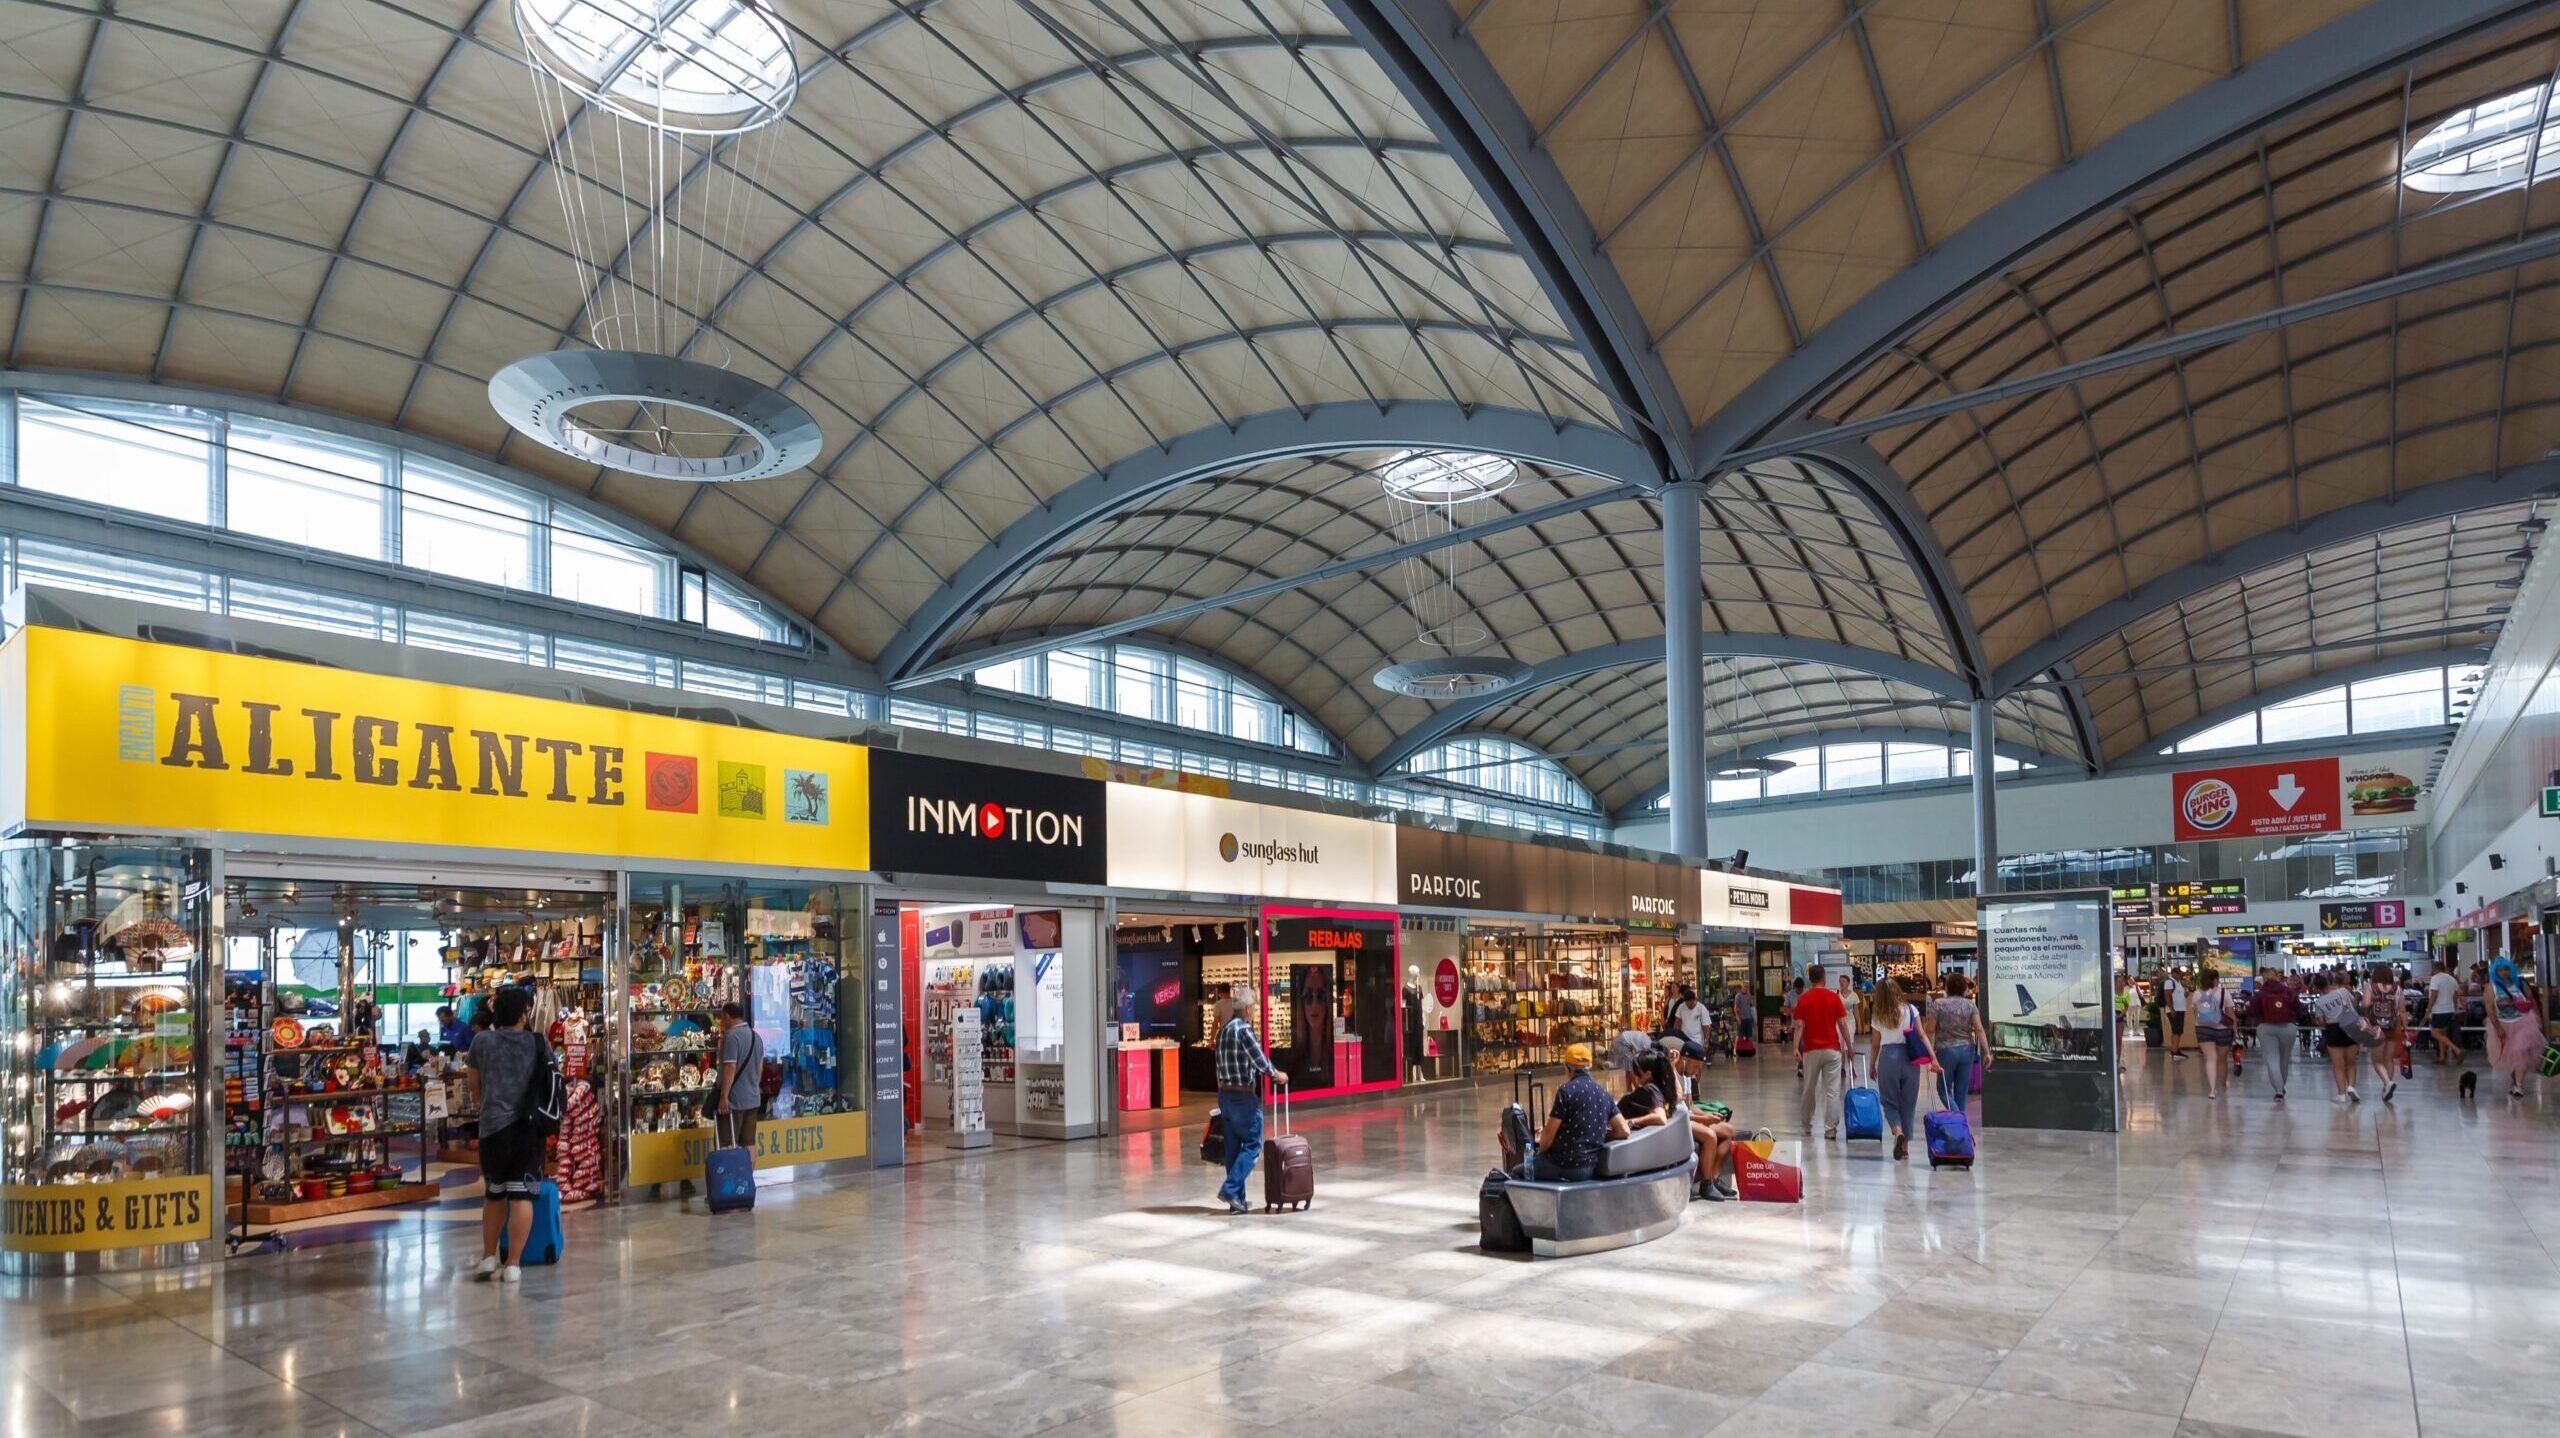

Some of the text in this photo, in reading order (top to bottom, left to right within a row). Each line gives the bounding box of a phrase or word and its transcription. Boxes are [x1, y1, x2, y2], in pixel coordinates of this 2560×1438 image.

[160, 692, 625, 806] ALICANTE
[2345, 772, 2394, 783] WHOPPER
[2190, 788, 2228, 808] BURGER
[2192, 796, 2231, 820] KING
[2250, 818, 2270, 826] JUSTO
[2292, 815, 2308, 823] JUST
[2309, 813, 2327, 822] HERE
[1242, 839, 1319, 865] sunglass hut
[1411, 873, 1480, 898] PARFOIS
[1632, 895, 1675, 915] PARFOIS
[1733, 890, 1766, 906] PETRA MORA
[2380, 905, 2396, 924] B
[994, 921, 1008, 939] €10
[1147, 932, 1160, 943] hut
[2029, 925, 2047, 933] más
[1308, 929, 1363, 948] REBAJAS
[1994, 935, 2043, 943] conexiones
[2042, 935, 2059, 943] hay,
[1994, 945, 2030, 953] pequeño
[2052, 943, 2083, 951] mundo.
[1995, 972, 2027, 980] Alicante
[771, 1130, 780, 1154] &
[785, 1125, 823, 1154] GIFTS
[1746, 1161, 1764, 1169] Date
[1746, 1171, 1780, 1180] capricho
[96, 1196, 115, 1231] &
[125, 1190, 200, 1231] GIFTS
